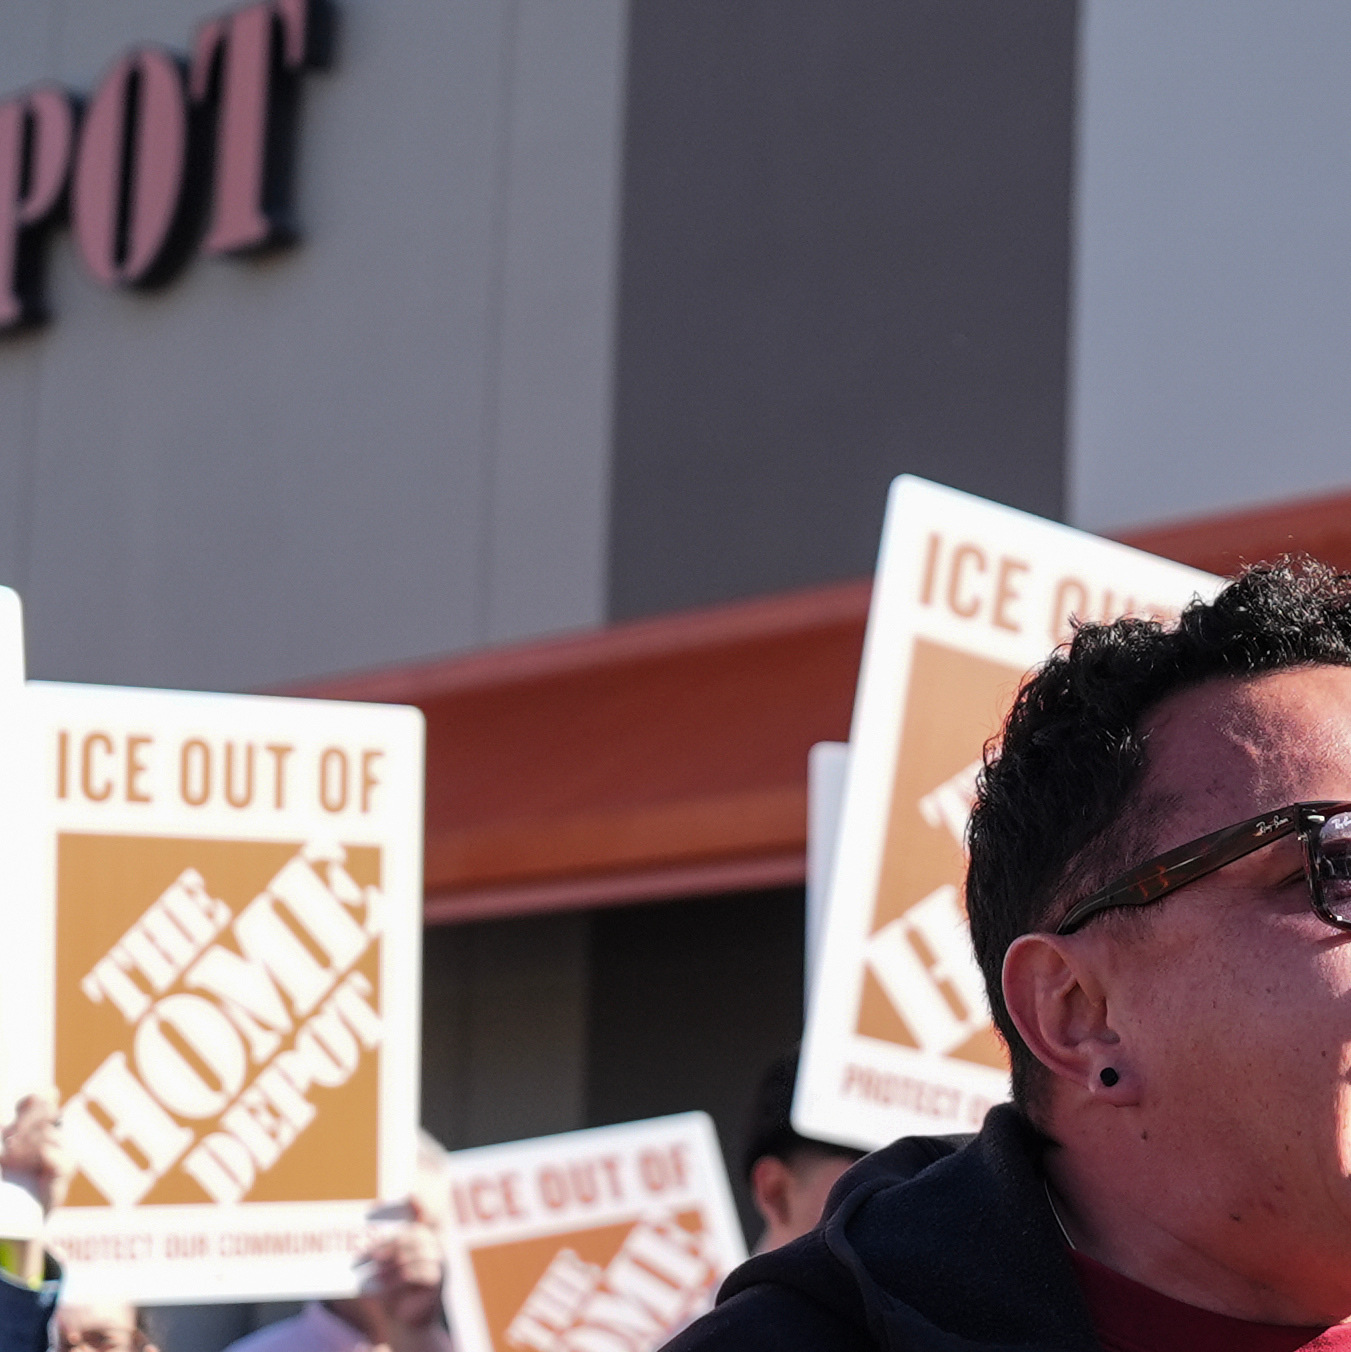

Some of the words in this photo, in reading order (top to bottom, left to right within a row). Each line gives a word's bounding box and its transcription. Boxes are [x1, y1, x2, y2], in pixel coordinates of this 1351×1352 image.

[919, 531, 1031, 635] ICE
[56, 730, 154, 803] ICE
[179, 737, 296, 809] OUT
[318, 747, 386, 814] OF
[56, 843, 383, 1207] HOME
[80, 866, 234, 1025] THE
[182, 969, 382, 1203] DEPOT
